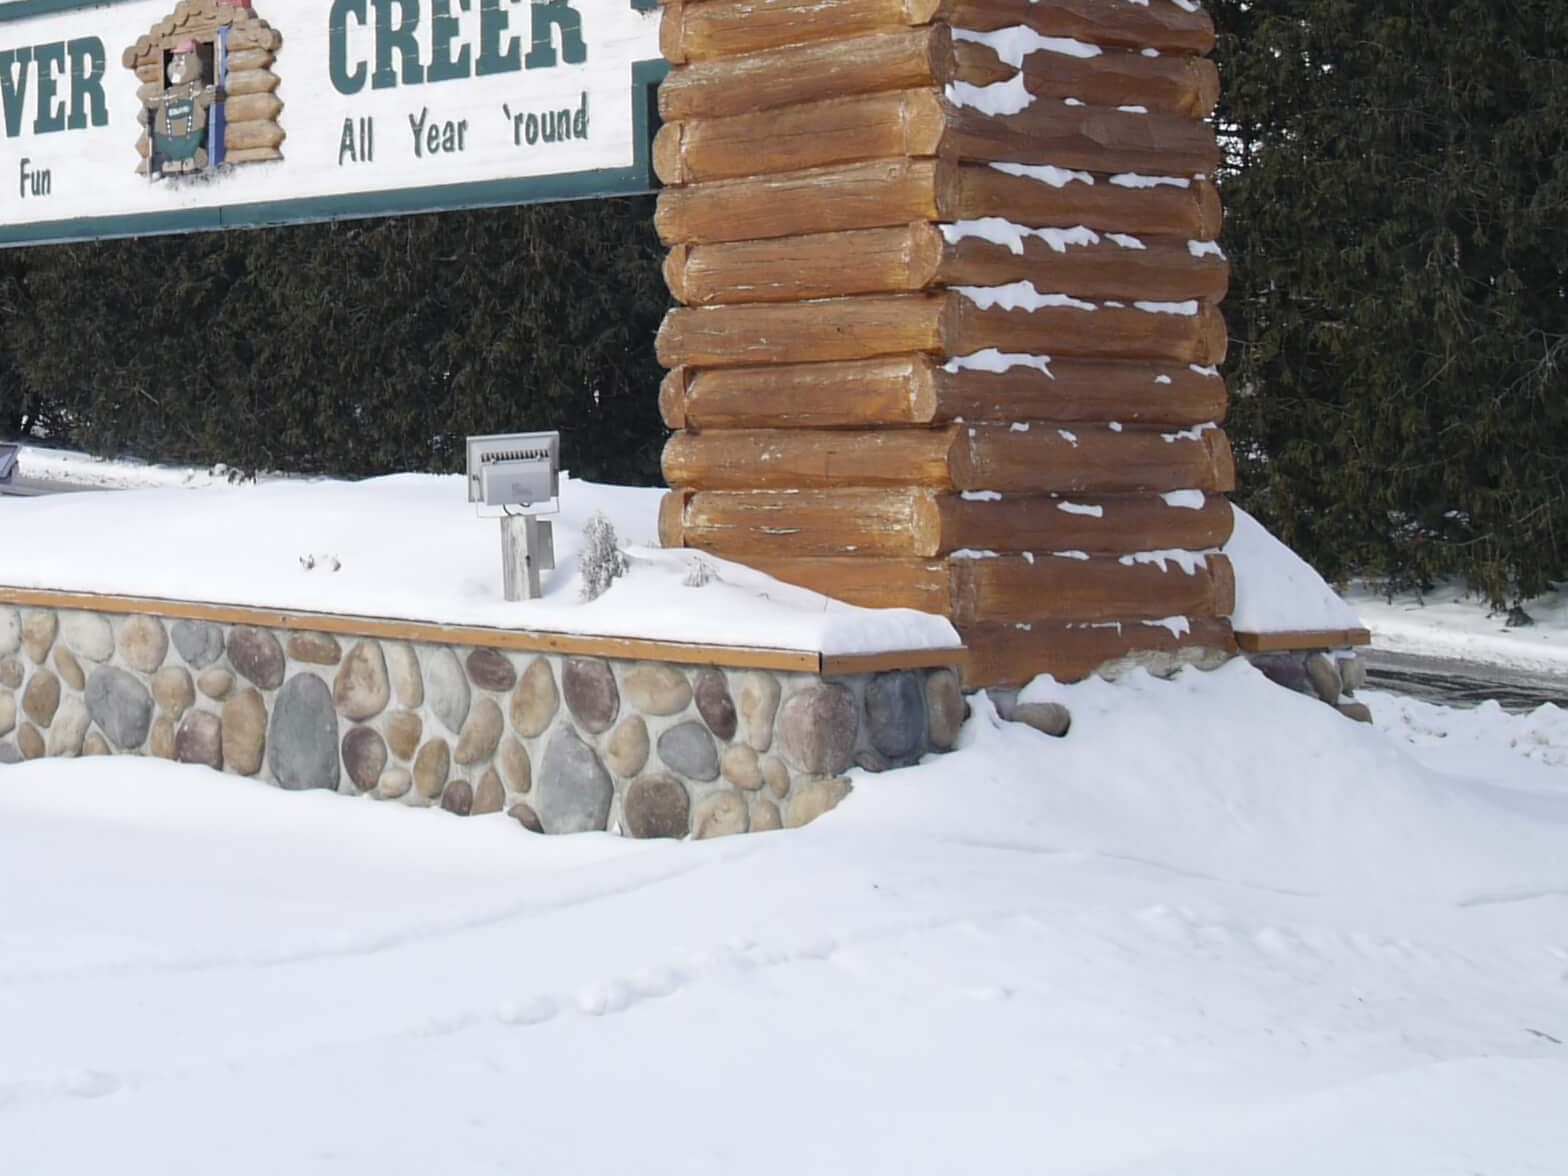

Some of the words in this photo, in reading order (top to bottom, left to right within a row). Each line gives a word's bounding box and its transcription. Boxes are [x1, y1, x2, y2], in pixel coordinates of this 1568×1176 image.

[338, 116, 374, 166] All
[409, 106, 468, 158] Year
[20, 157, 51, 199] Fun
